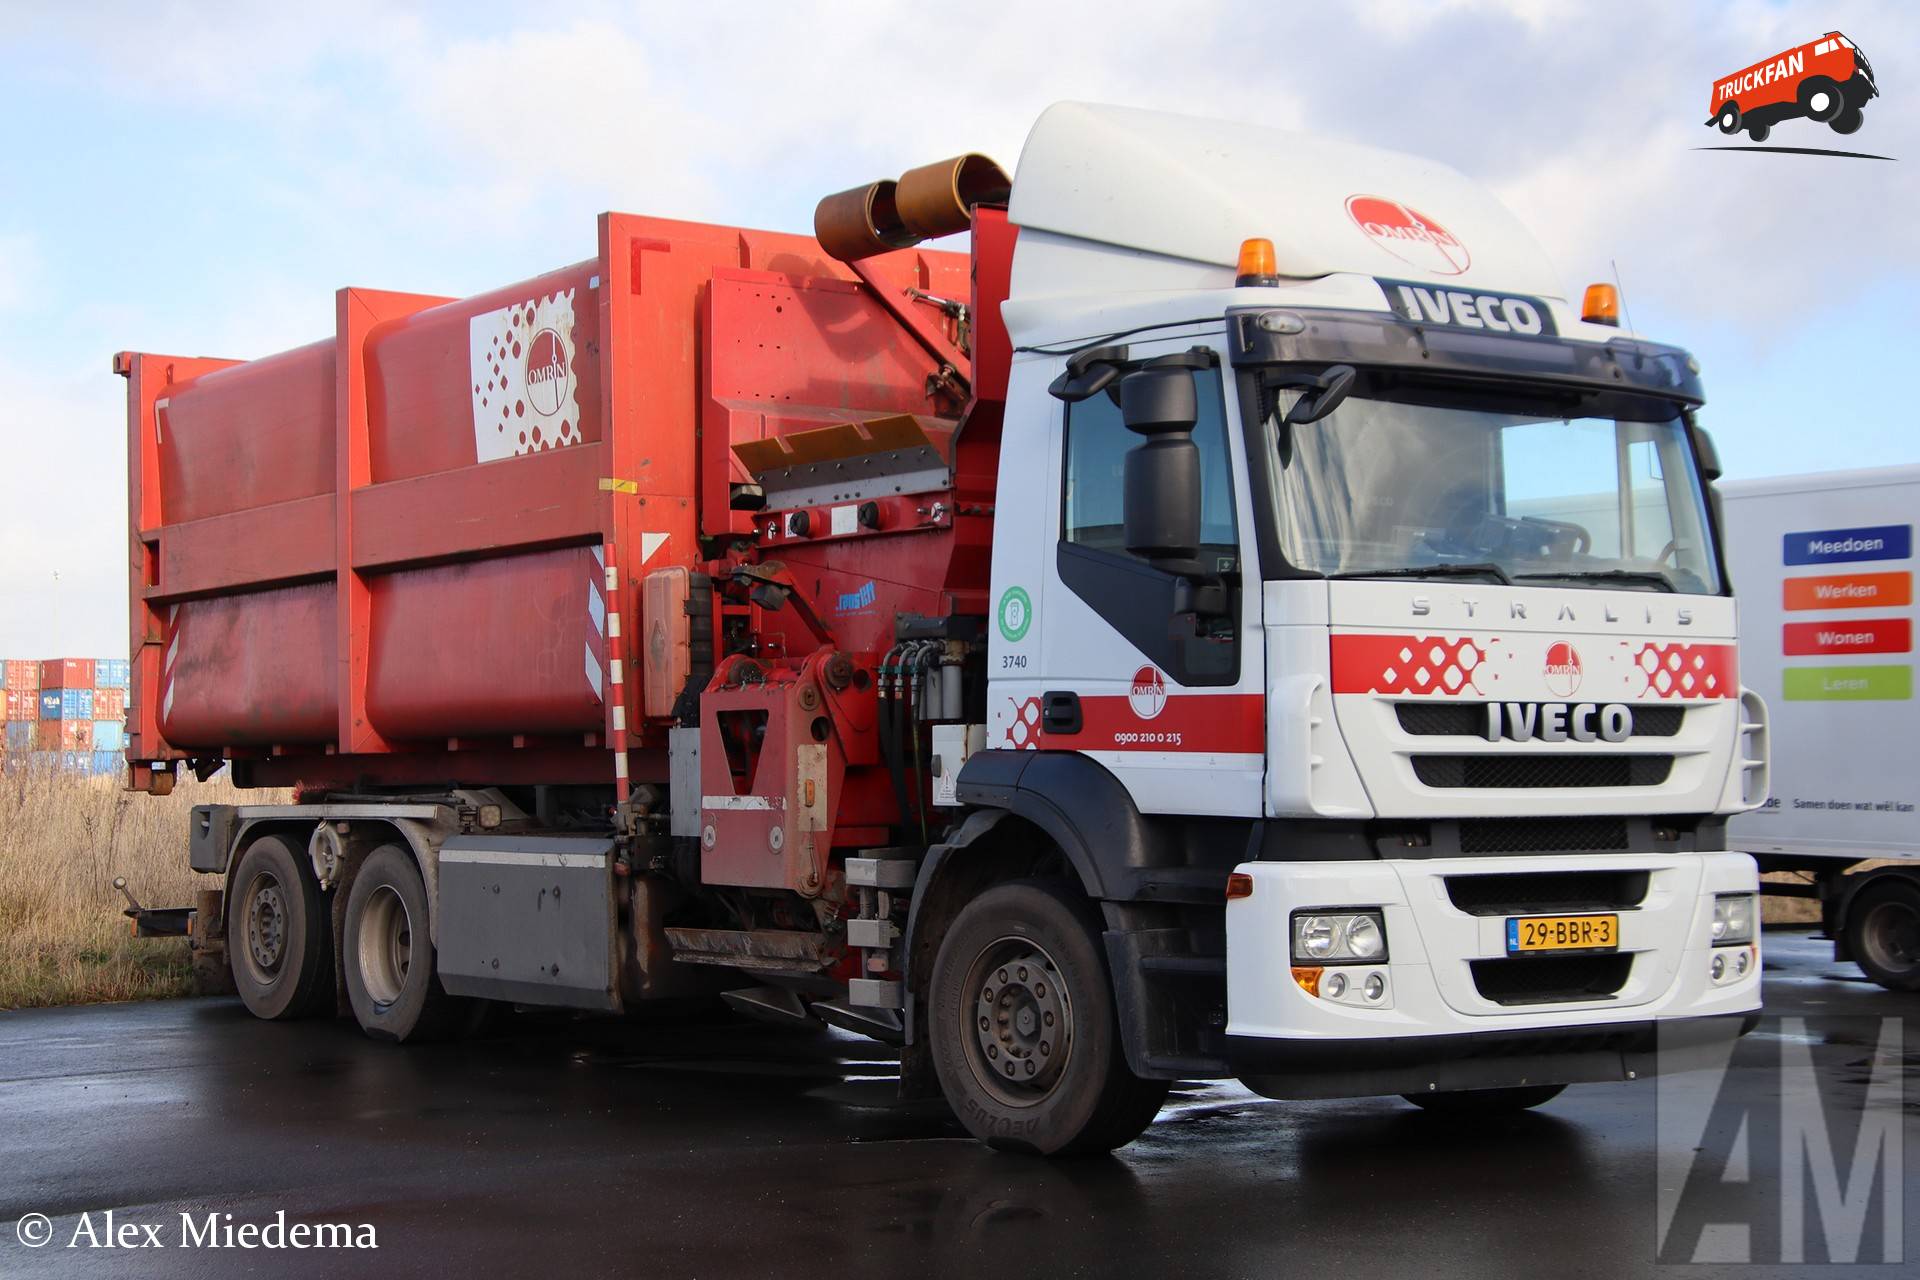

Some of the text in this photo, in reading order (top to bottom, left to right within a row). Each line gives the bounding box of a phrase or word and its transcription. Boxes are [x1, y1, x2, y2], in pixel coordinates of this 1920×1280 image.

[1363, 221, 1459, 247] OMRIN
[1397, 285, 1543, 336] IVECO
[528, 362, 567, 386] OMRIN
[1808, 536, 1884, 555] Meedoen
[1815, 582, 1878, 600] Werken
[1411, 596, 1694, 626] STRALIS
[1817, 630, 1874, 647] Wonen
[1002, 655, 1027, 668] 3740
[1545, 664, 1582, 676] OMRIN
[1132, 685, 1164, 697] OMRIN
[1823, 675, 1869, 692] Leren
[1486, 702, 1634, 742] IVECO
[1114, 732, 1139, 745] 0900
[1140, 732, 1156, 743] 210
[1166, 732, 1182, 746] 215
[1793, 798, 1826, 809] Samen
[1828, 799, 1852, 810] doen
[1854, 801, 1873, 811] wat
[1525, 921, 1610, 946] 29-BBR-3
